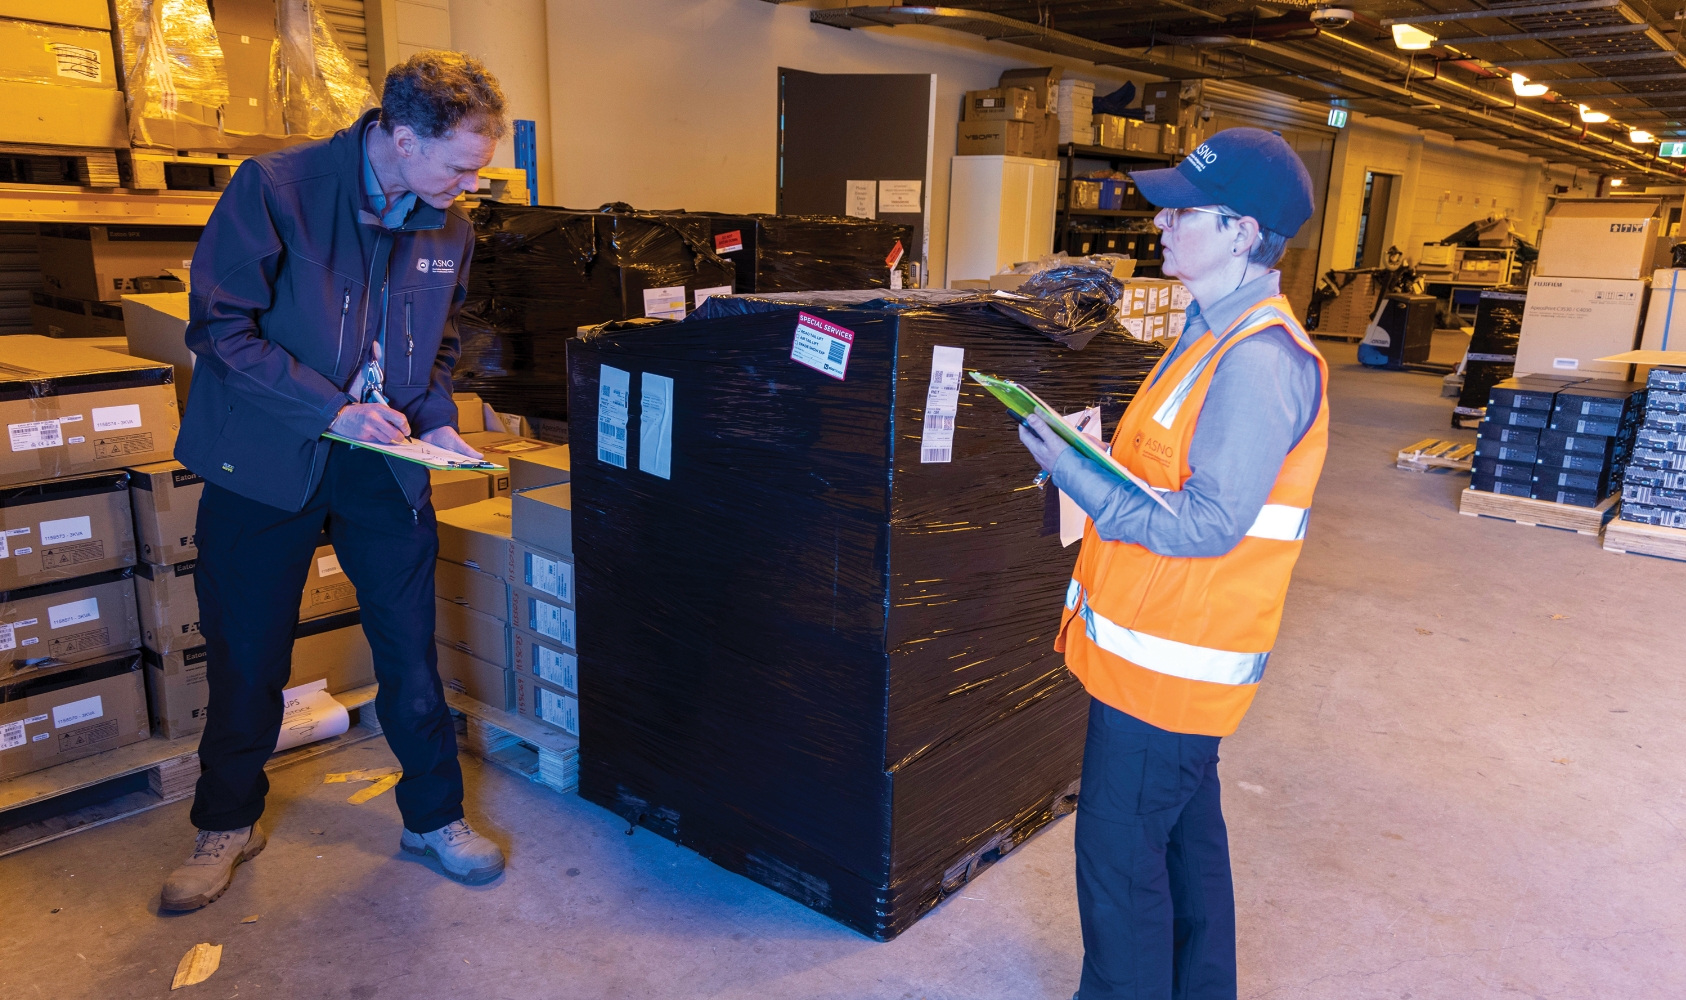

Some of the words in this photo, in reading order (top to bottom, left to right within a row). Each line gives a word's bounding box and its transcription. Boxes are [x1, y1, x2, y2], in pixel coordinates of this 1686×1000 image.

[800, 314, 822, 329] SPECIAL
[824, 324, 853, 340] SERVICES
[1145, 438, 1173, 458] ASNO
[175, 473, 196, 482] Eaton
[284, 698, 300, 708] UPS
[285, 706, 312, 715] STOCK
